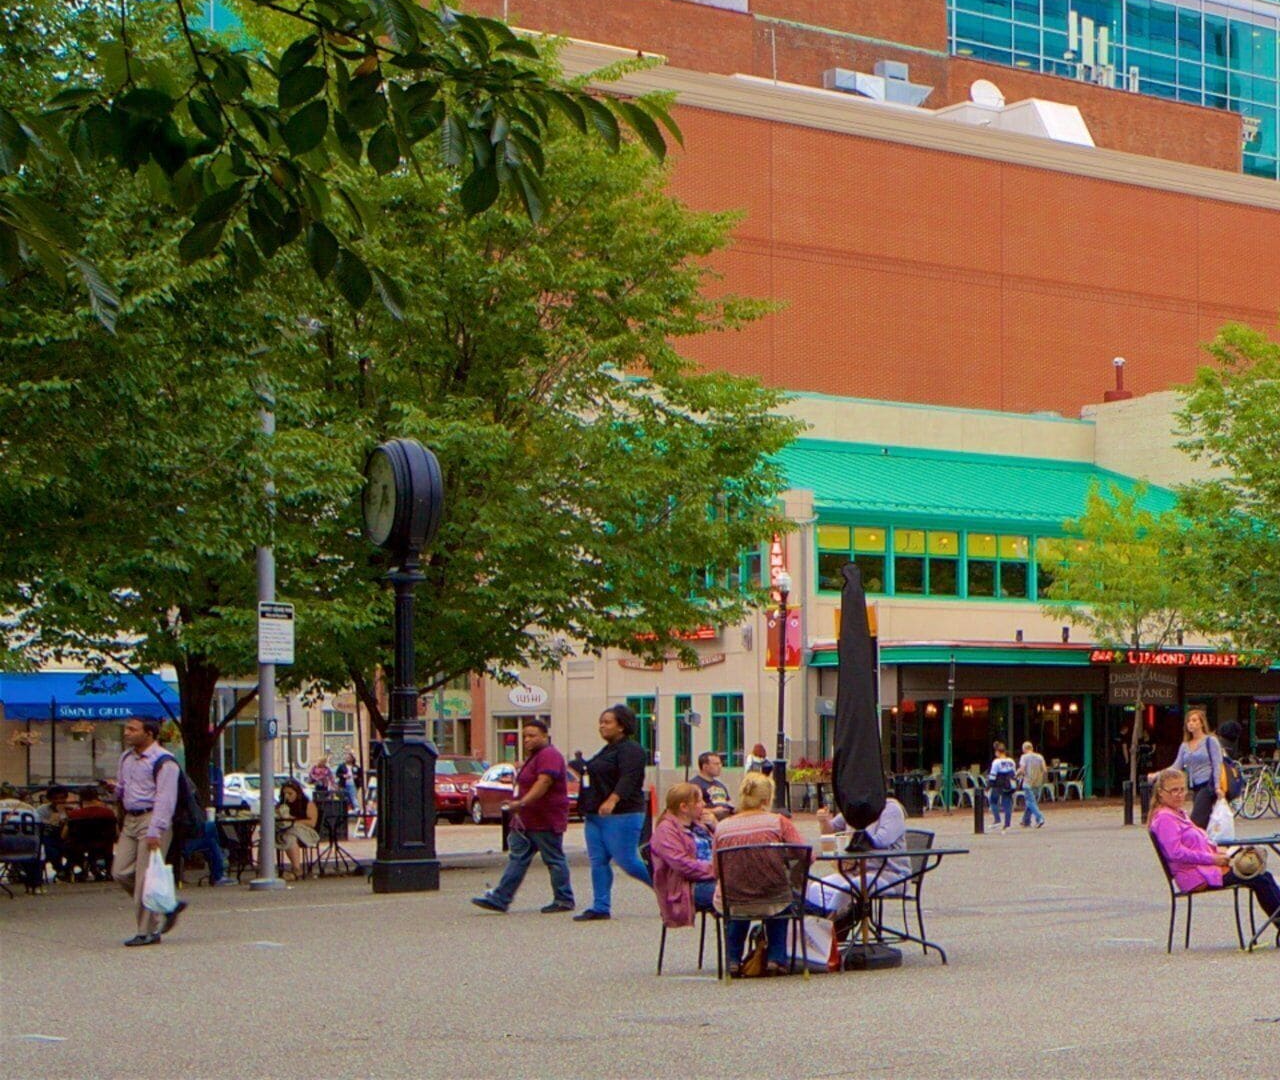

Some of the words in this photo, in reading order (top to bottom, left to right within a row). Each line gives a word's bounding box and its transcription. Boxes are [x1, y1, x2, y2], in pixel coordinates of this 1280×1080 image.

[1189, 653, 1238, 666] MARKET
[1114, 688, 1173, 697] ENTANCE
[60, 707, 94, 717] SIMPLE
[99, 707, 133, 717] GREEK
